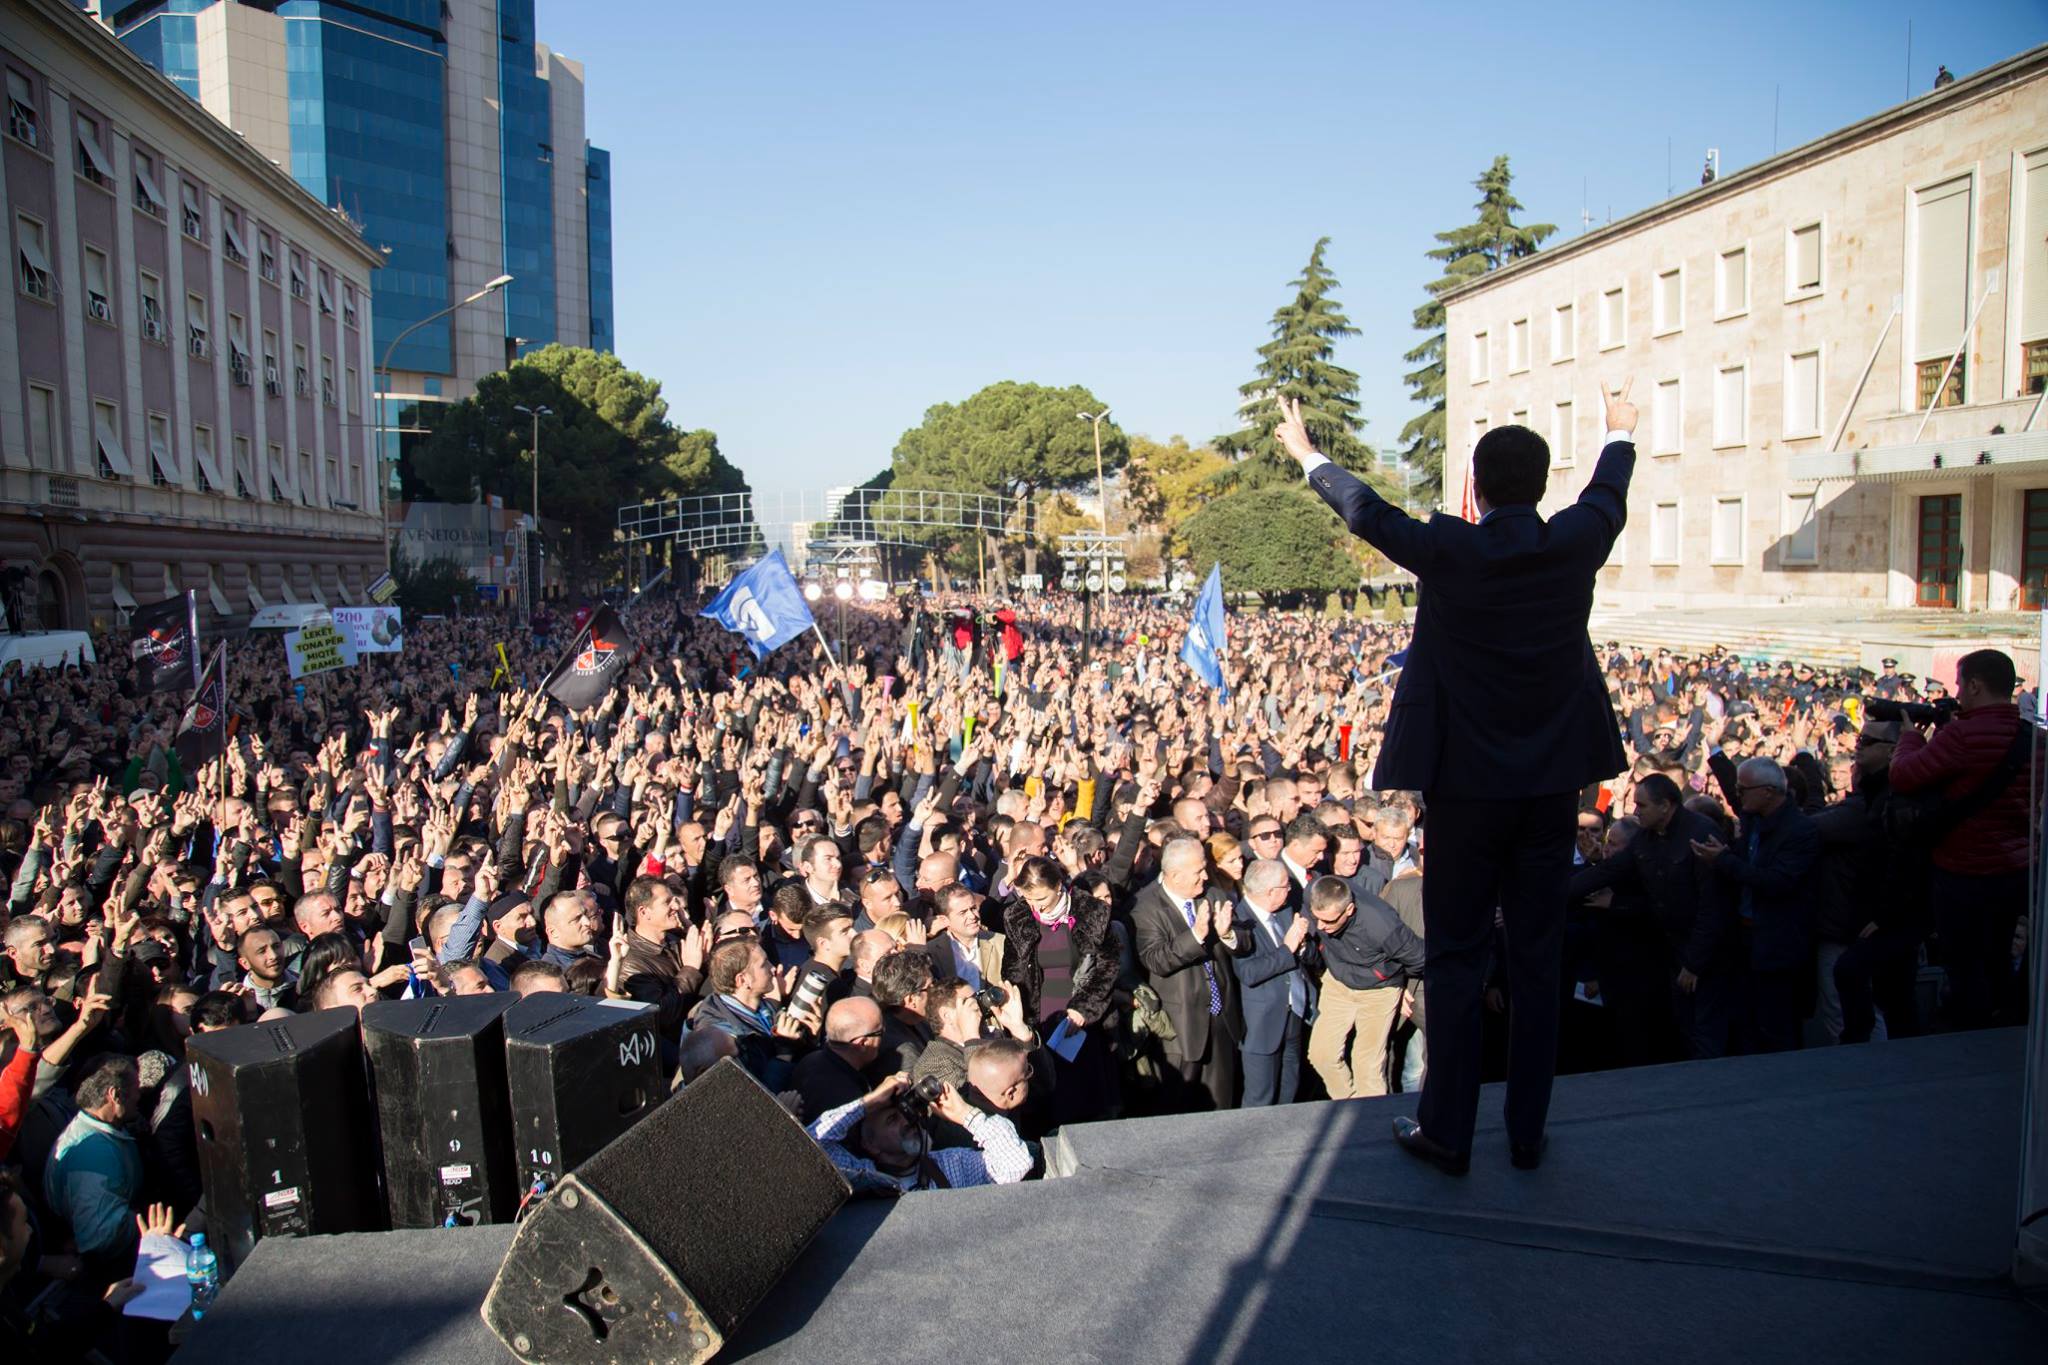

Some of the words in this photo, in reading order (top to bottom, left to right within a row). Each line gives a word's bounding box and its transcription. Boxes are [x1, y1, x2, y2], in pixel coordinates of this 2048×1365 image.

[407, 529, 460, 541] VENETO
[336, 612, 362, 623] 200
[296, 641, 323, 652] TONA
[449, 1139, 461, 1152] 9
[530, 1148, 552, 1164] 10
[271, 1170, 282, 1184] 1
